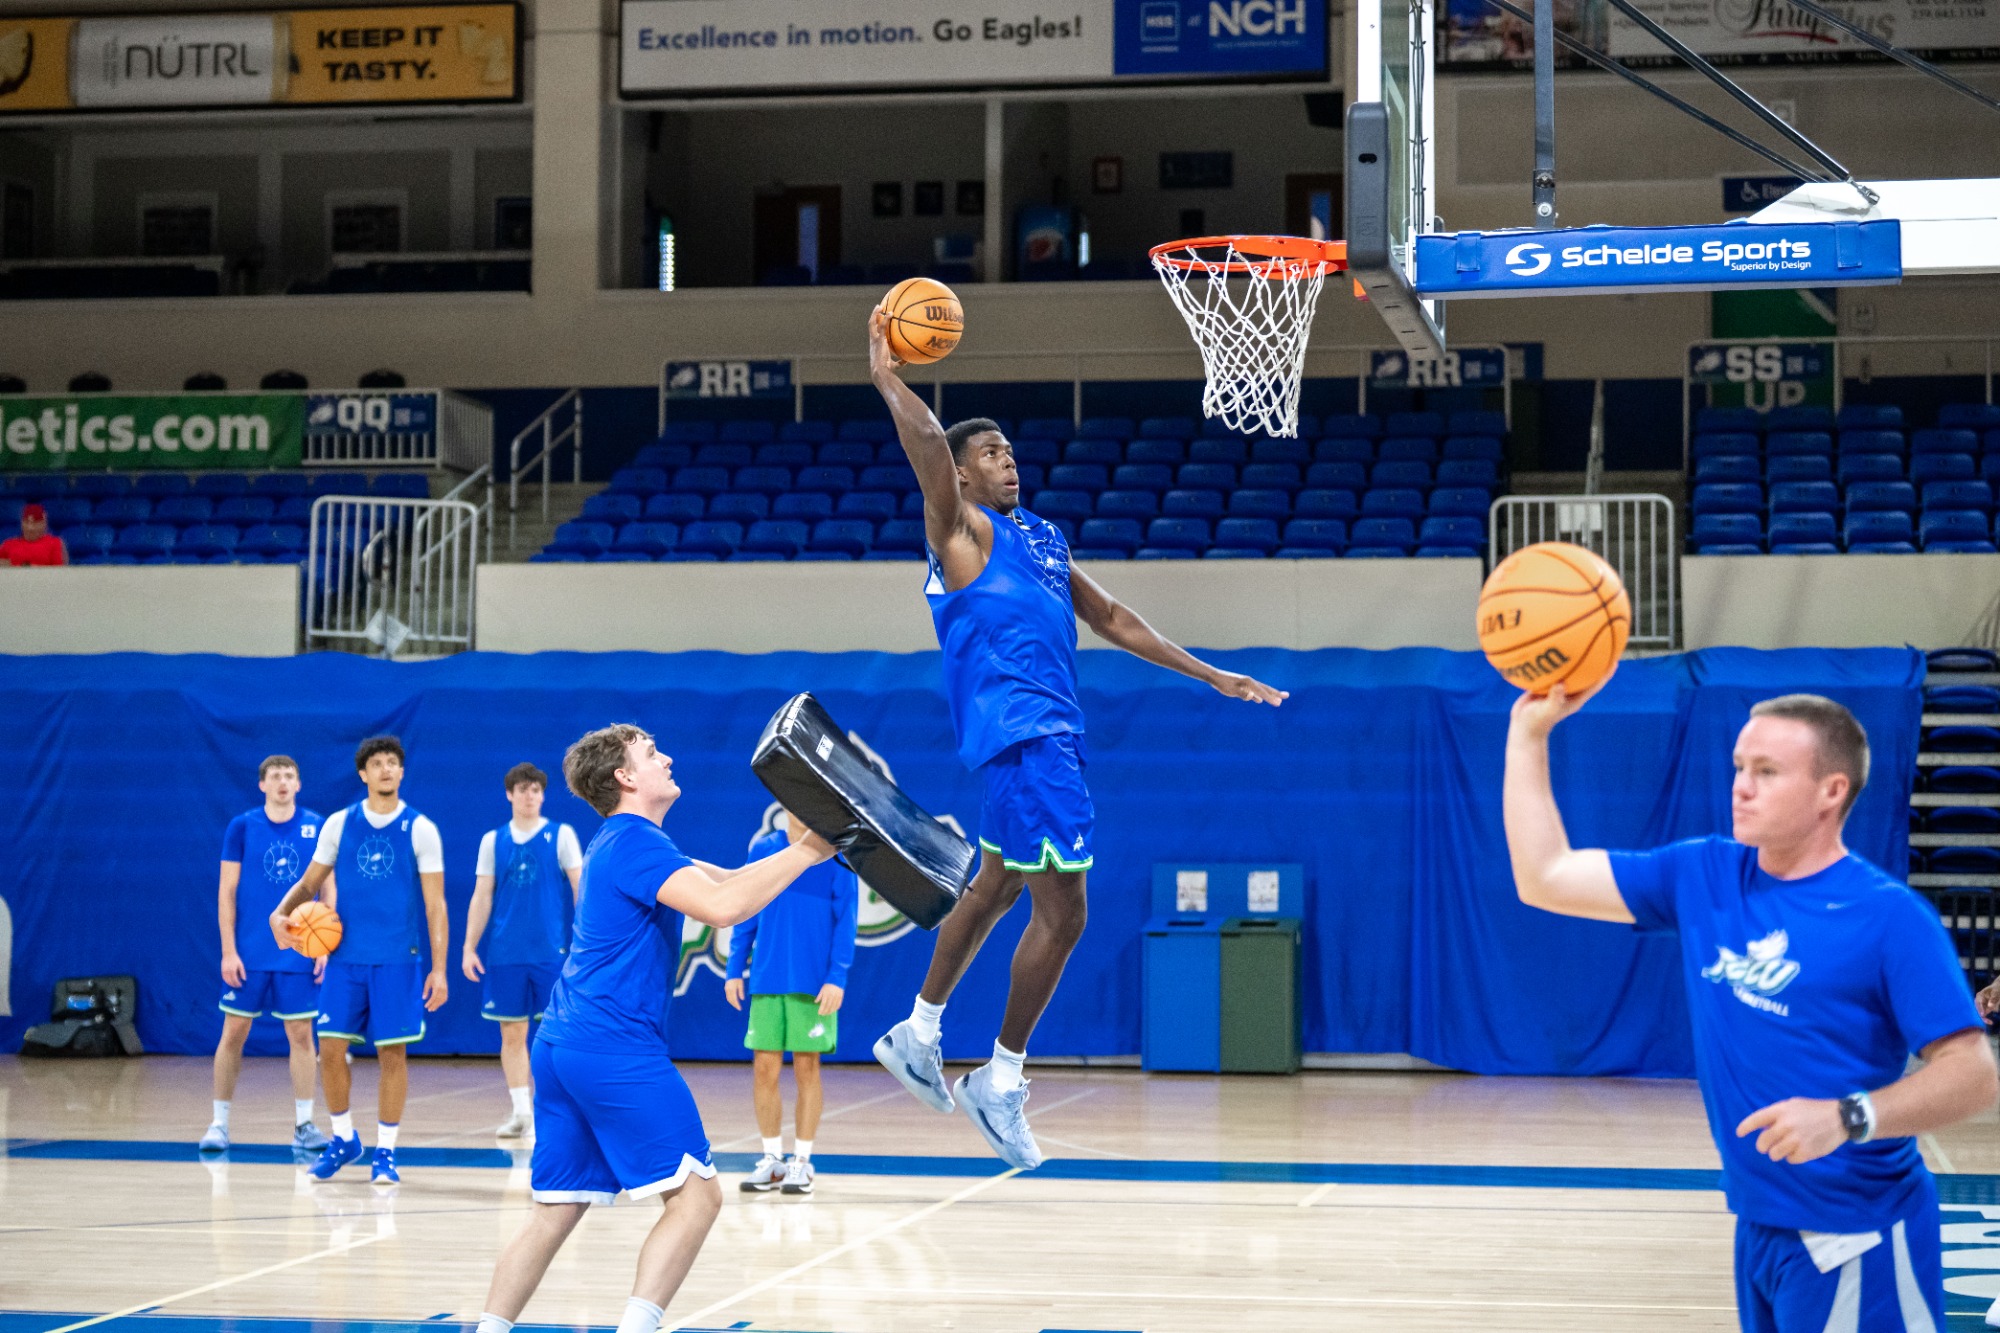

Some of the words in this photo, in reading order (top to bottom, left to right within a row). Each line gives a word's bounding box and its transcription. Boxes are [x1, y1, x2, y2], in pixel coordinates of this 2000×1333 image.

[638, 25, 777, 51] Excellence
[787, 24, 810, 46] in
[820, 22, 923, 46] motion.
[933, 18, 972, 43] Go
[982, 15, 1083, 47] Eagles!
[1208, 0, 1307, 37] NCH
[317, 27, 405, 50] KEEP
[414, 25, 444, 47] IT
[322, 58, 437, 83] TASTY.
[1562, 244, 1693, 267] Schelde
[1701, 238, 1811, 266] Sports
[1731, 262, 1767, 272] Superior
[1768, 261, 1780, 271] by
[1781, 260, 1812, 271] Design
[699, 361, 751, 398] RR
[1726, 345, 1783, 382] SS
[0, 404, 270, 454] etics.com
[337, 397, 390, 432] QQ
